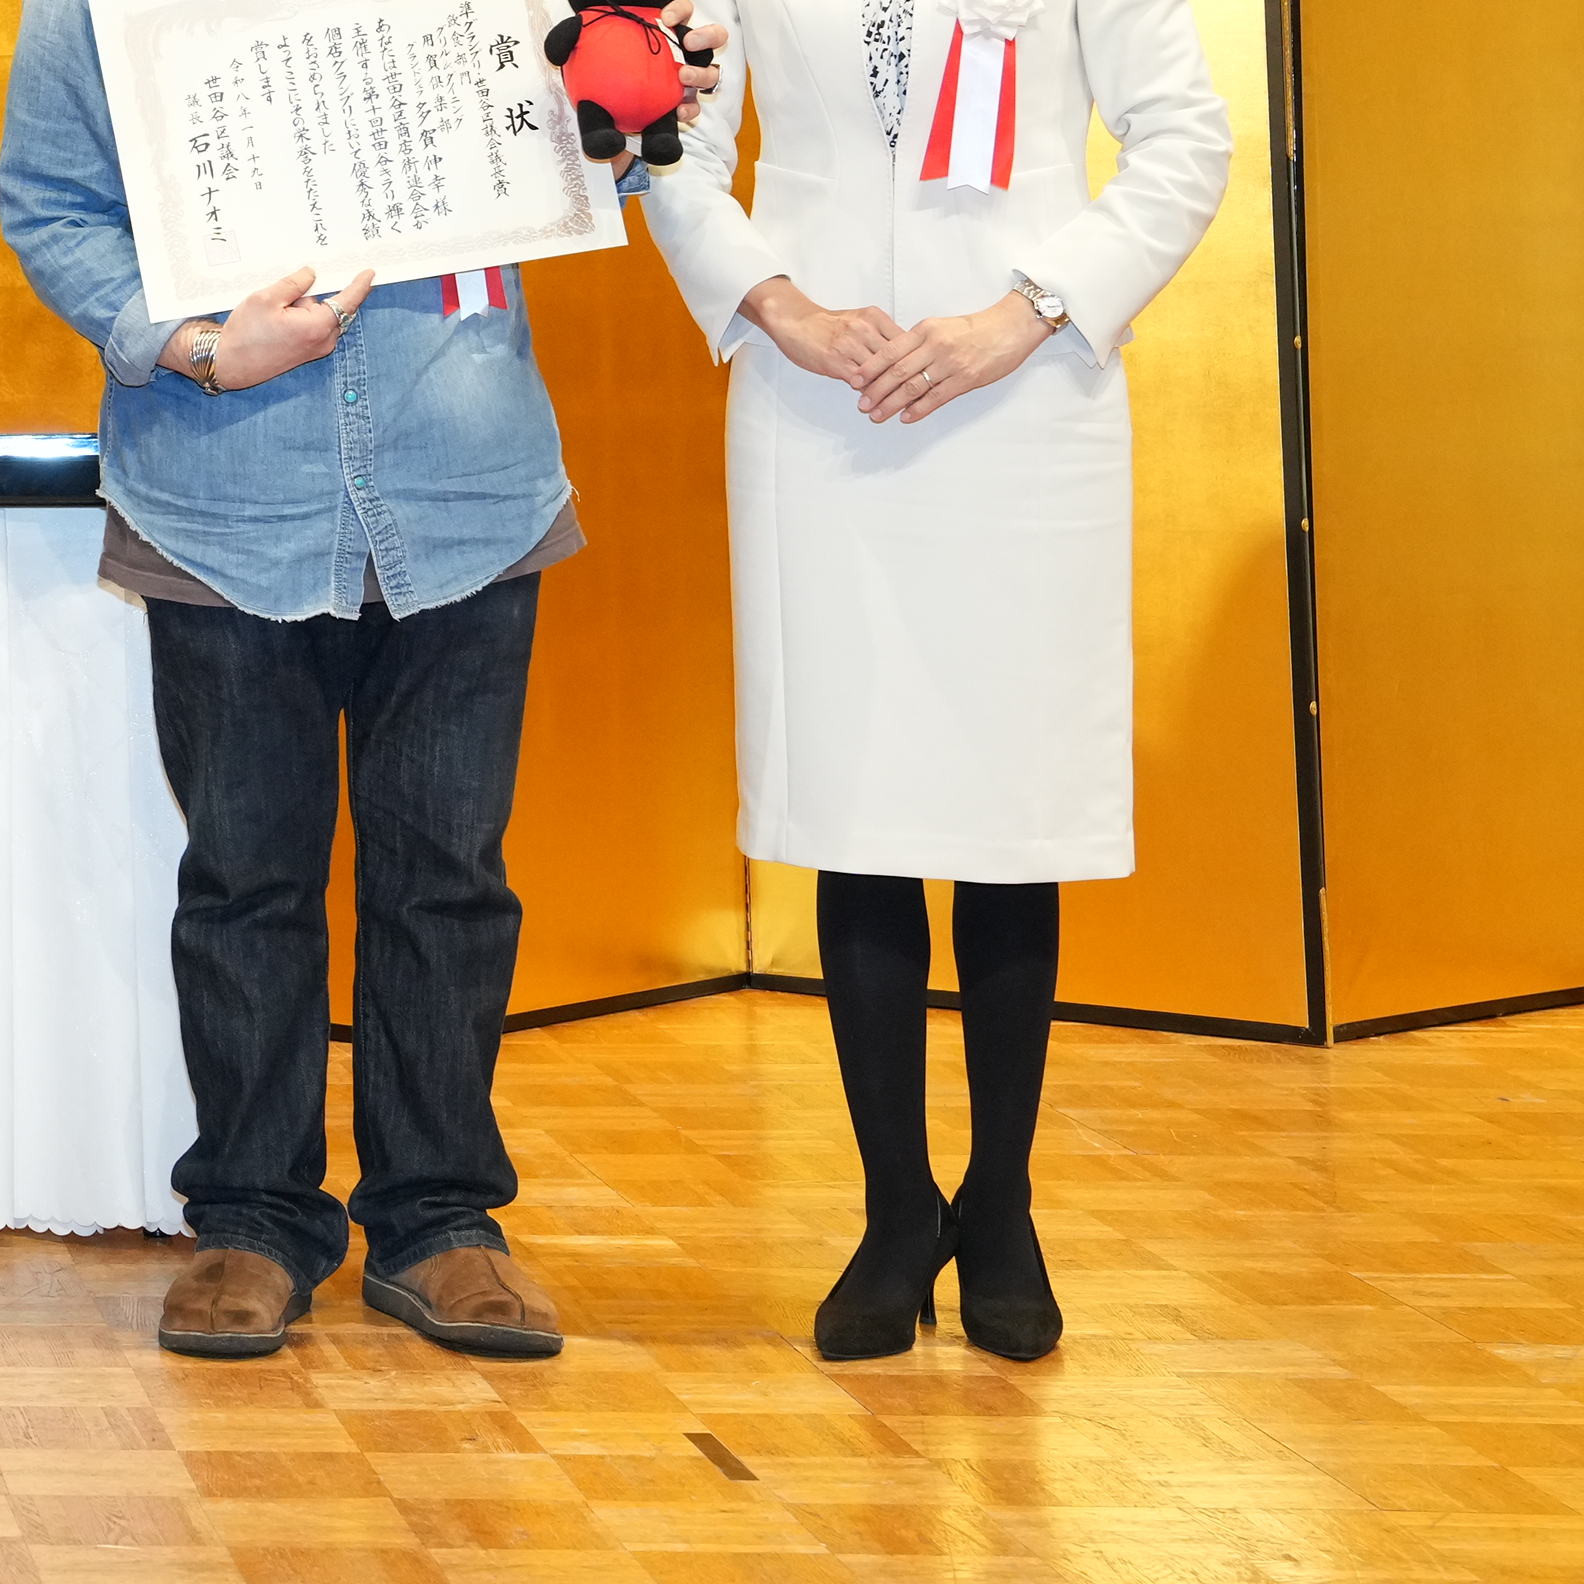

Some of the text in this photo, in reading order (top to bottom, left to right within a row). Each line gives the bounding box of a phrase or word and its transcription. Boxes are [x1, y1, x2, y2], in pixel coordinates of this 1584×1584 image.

[251, 40, 275, 105] 賞します
[302, 33, 335, 154] をおさめられました
[447, 14, 471, 85] 飲食部門
[459, 1, 510, 199] 準グランプリ・世田谷区議会議長賞
[488, 34, 539, 136] 賞状
[204, 75, 239, 181] 世田谷区議会
[229, 58, 263, 190] 令和八年一月十九日
[277, 35, 327, 245] よってここにその栄誉をたたえこれを
[325, 27, 381, 240] 個店グランプリにおいて優秀な成績
[350, 23, 404, 233] 主催する第十回世田谷キラリ輝く
[375, 18, 430, 230] あなたは世田谷区商店街連合会が
